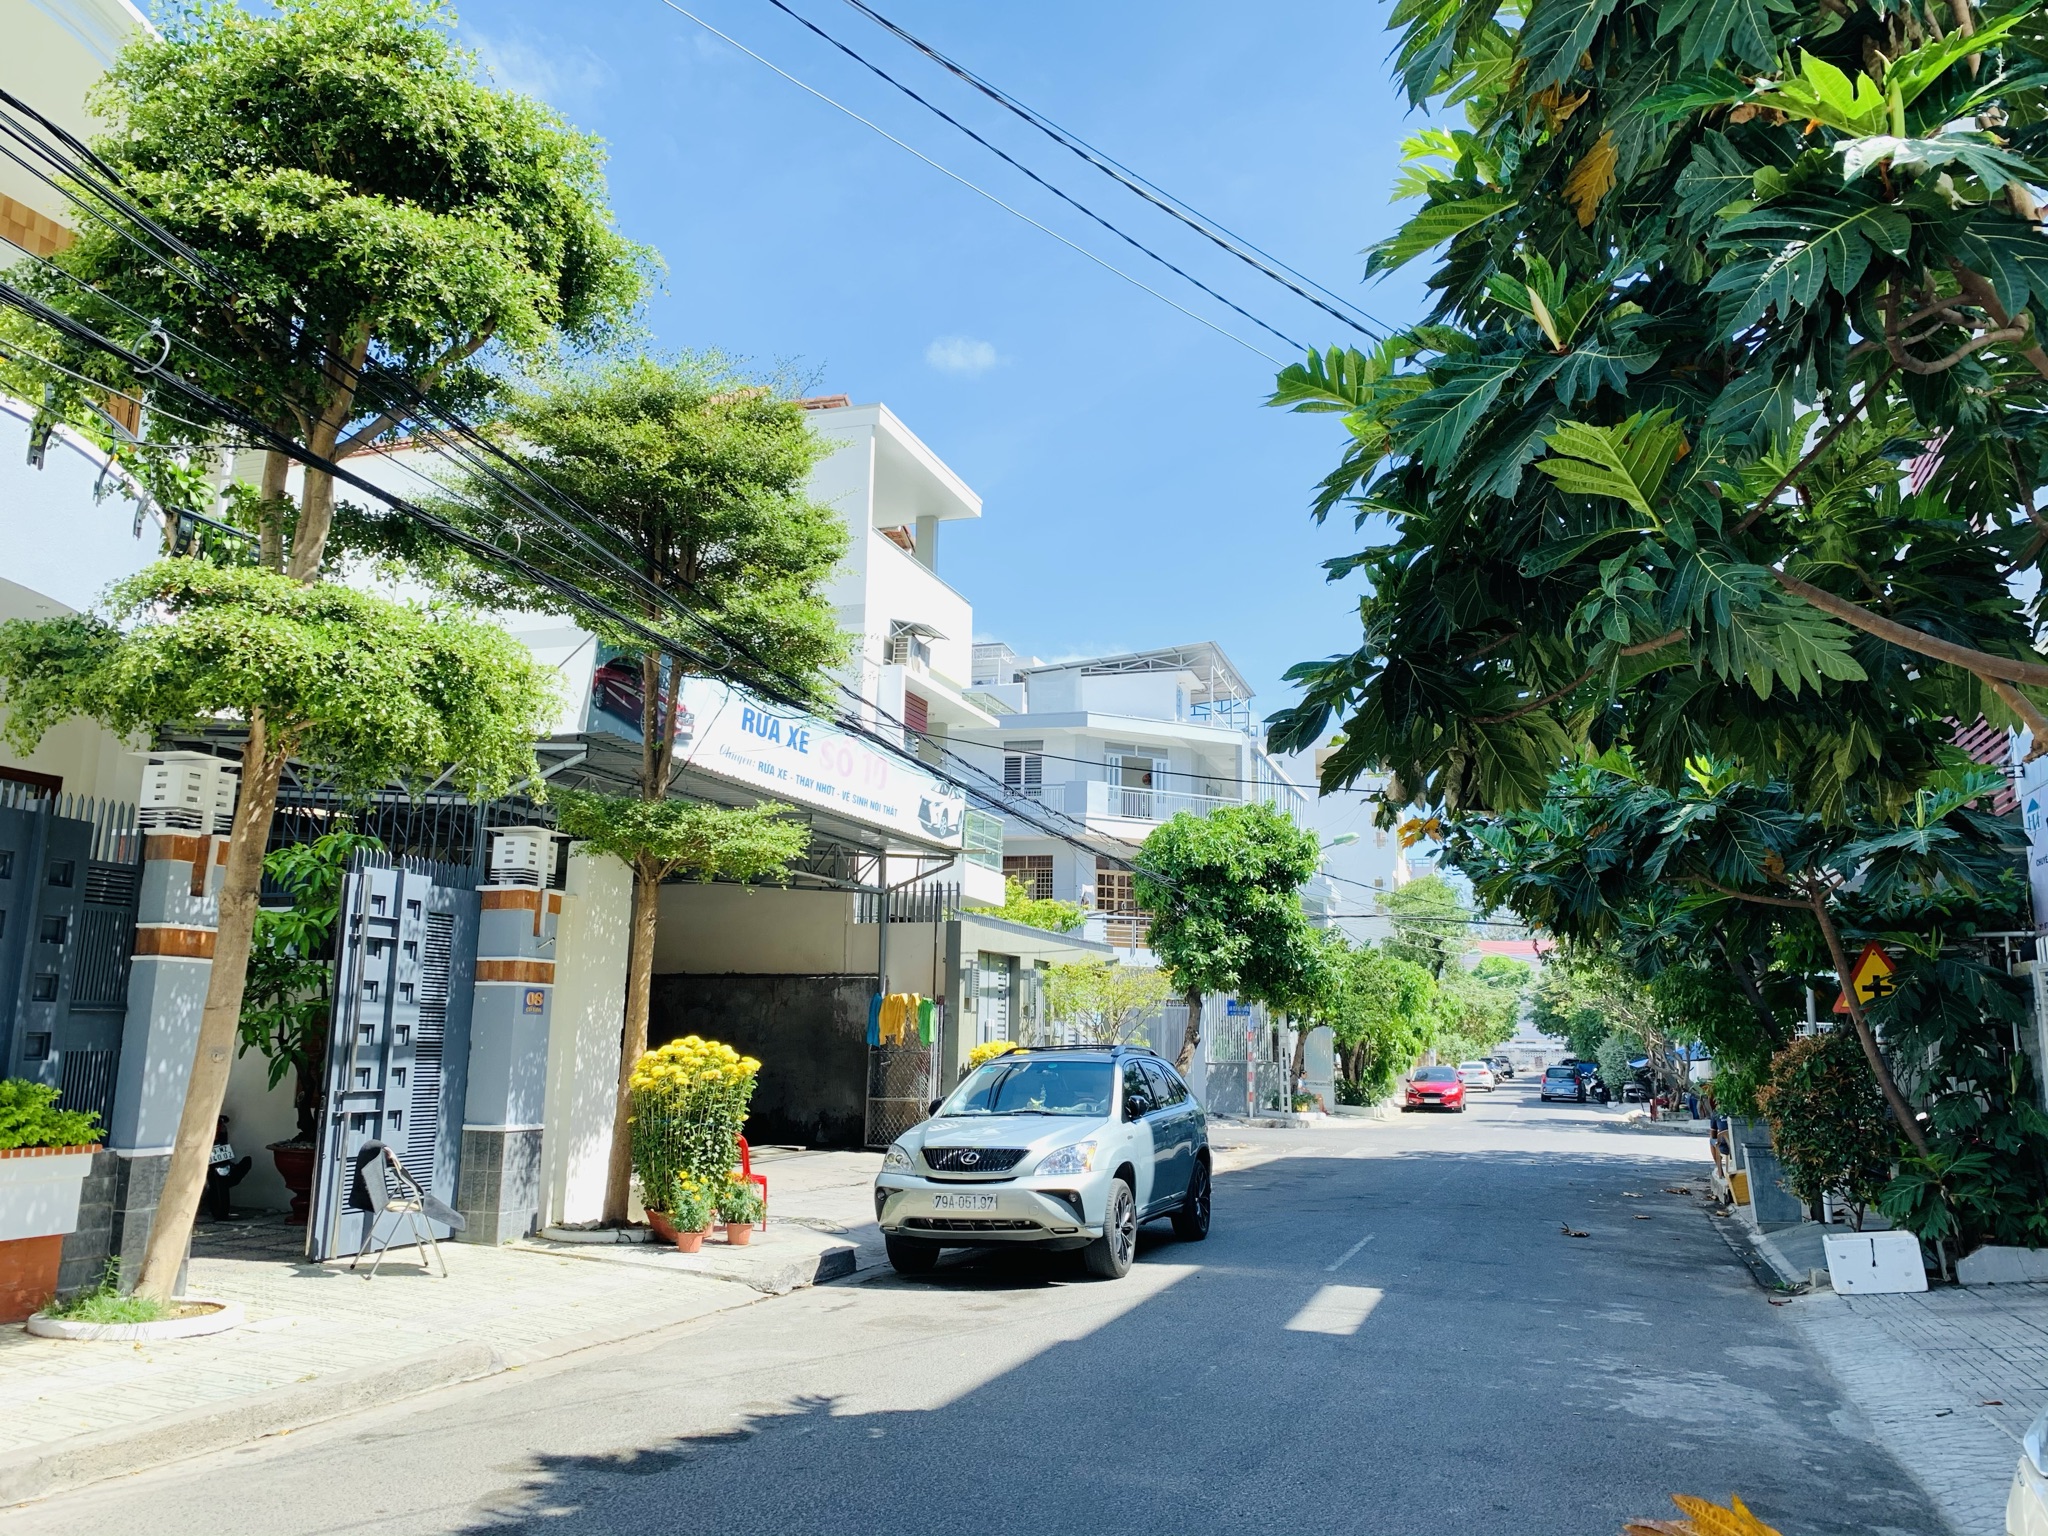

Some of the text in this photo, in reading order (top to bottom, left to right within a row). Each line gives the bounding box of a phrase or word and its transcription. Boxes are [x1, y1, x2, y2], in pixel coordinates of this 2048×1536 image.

[786, 725, 810, 755] XE
[777, 767, 788, 781] XE
[796, 774, 815, 790] THAY
[852, 794, 869, 808] SINH
[526, 991, 544, 1006] 08
[935, 1194, 993, 1210] 79A-051.97
